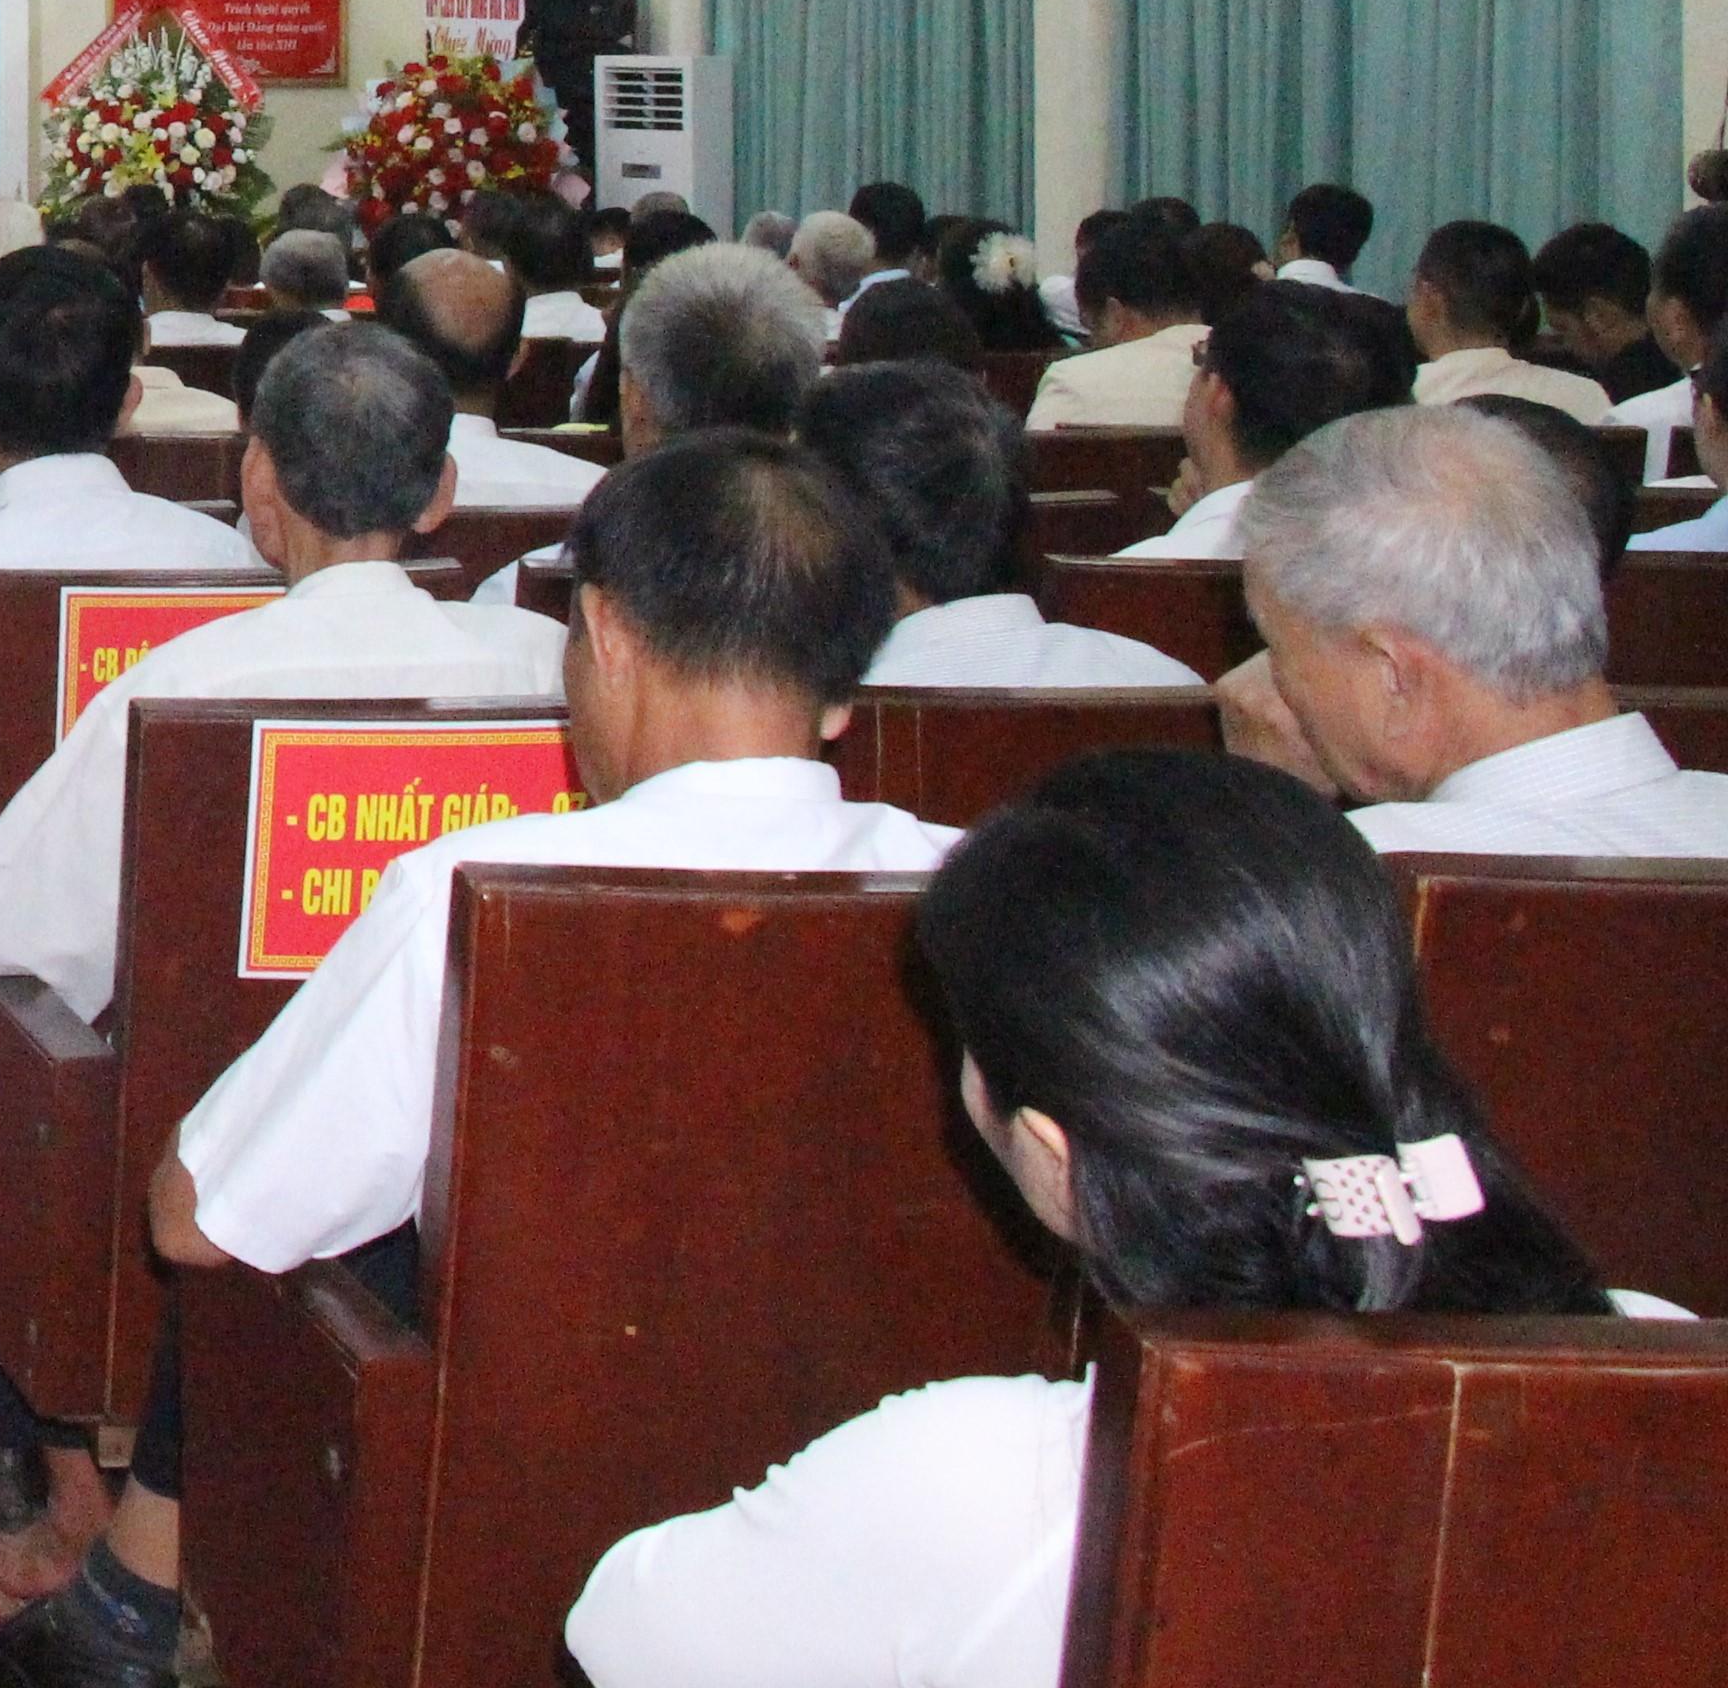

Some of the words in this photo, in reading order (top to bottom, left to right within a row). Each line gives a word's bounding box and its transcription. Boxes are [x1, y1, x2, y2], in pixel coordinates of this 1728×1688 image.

[92, 646, 120, 683] CB
[306, 792, 345, 842] CB
[355, 776, 435, 842] NHẤT
[302, 867, 352, 916] CHI
